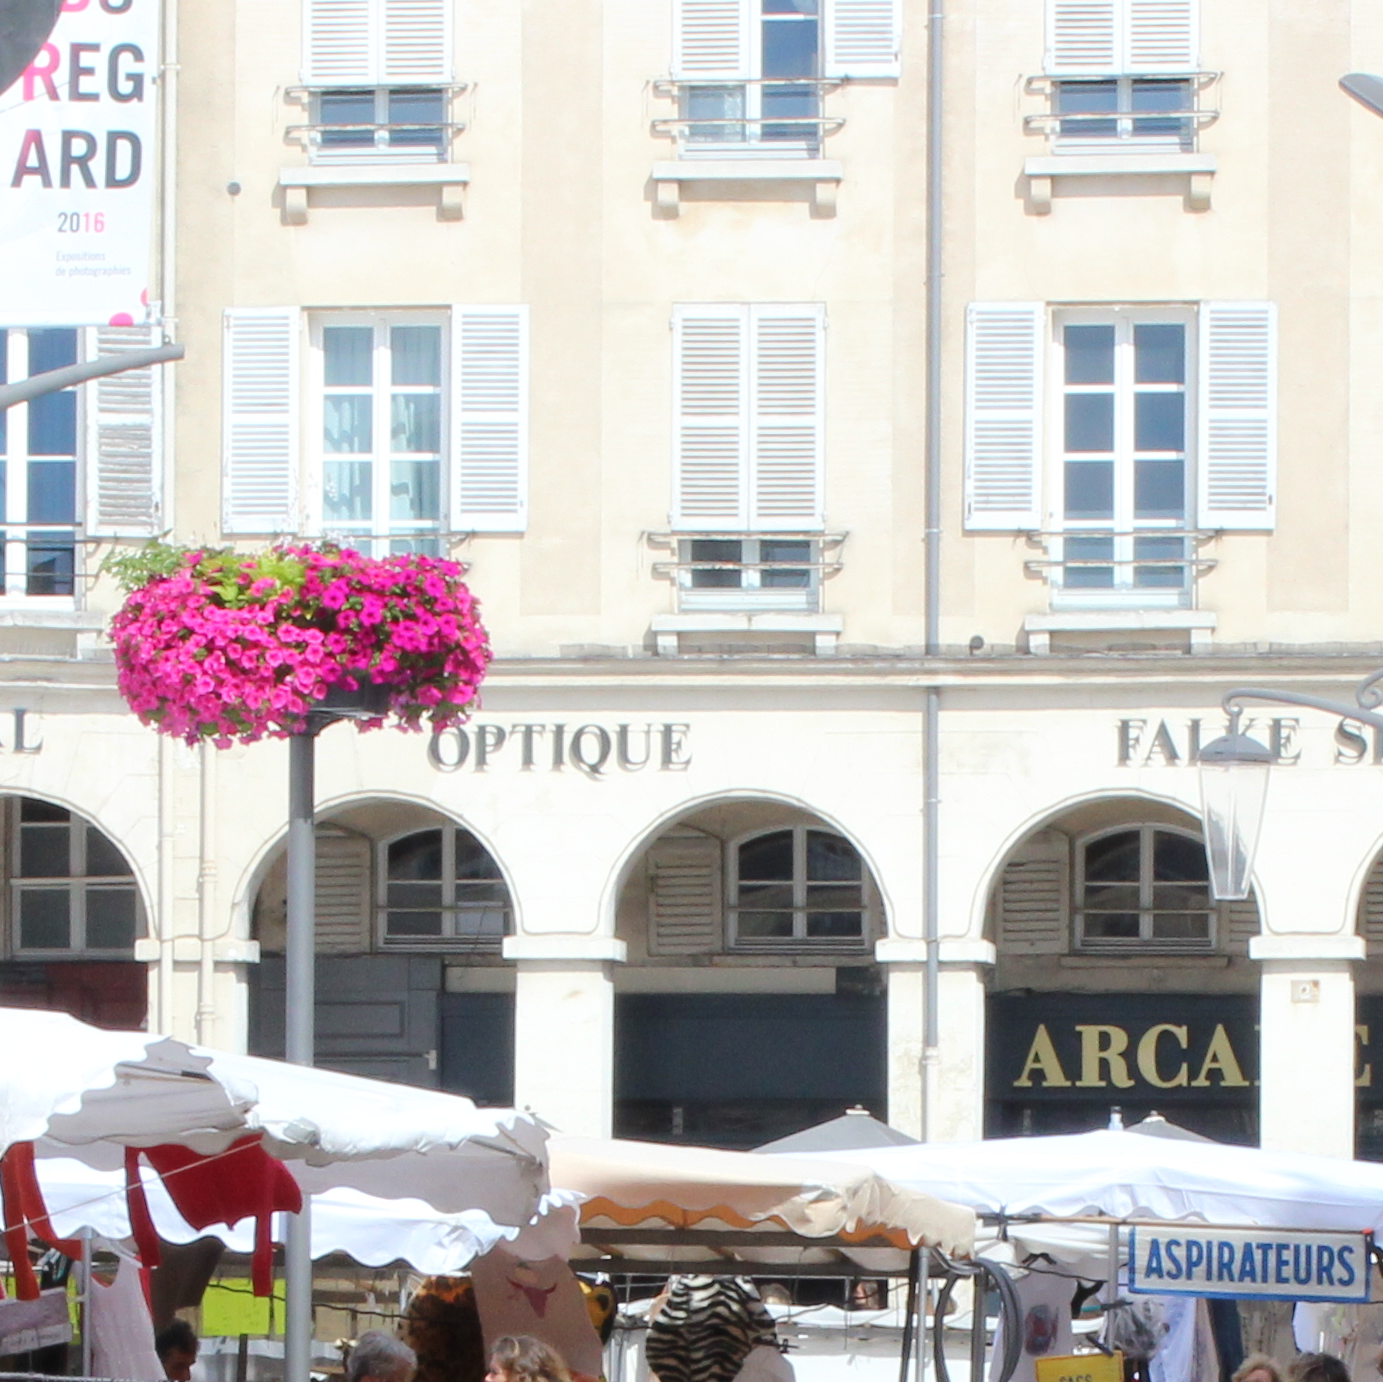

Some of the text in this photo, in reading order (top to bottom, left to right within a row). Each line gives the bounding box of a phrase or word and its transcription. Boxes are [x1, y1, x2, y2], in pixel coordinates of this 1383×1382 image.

[10, 129, 143, 189] ARD
[57, 212, 105, 234] 2016
[427, 722, 694, 783] OPTIQUE
[1144, 1238, 1356, 1287] ASPIRATEURS
